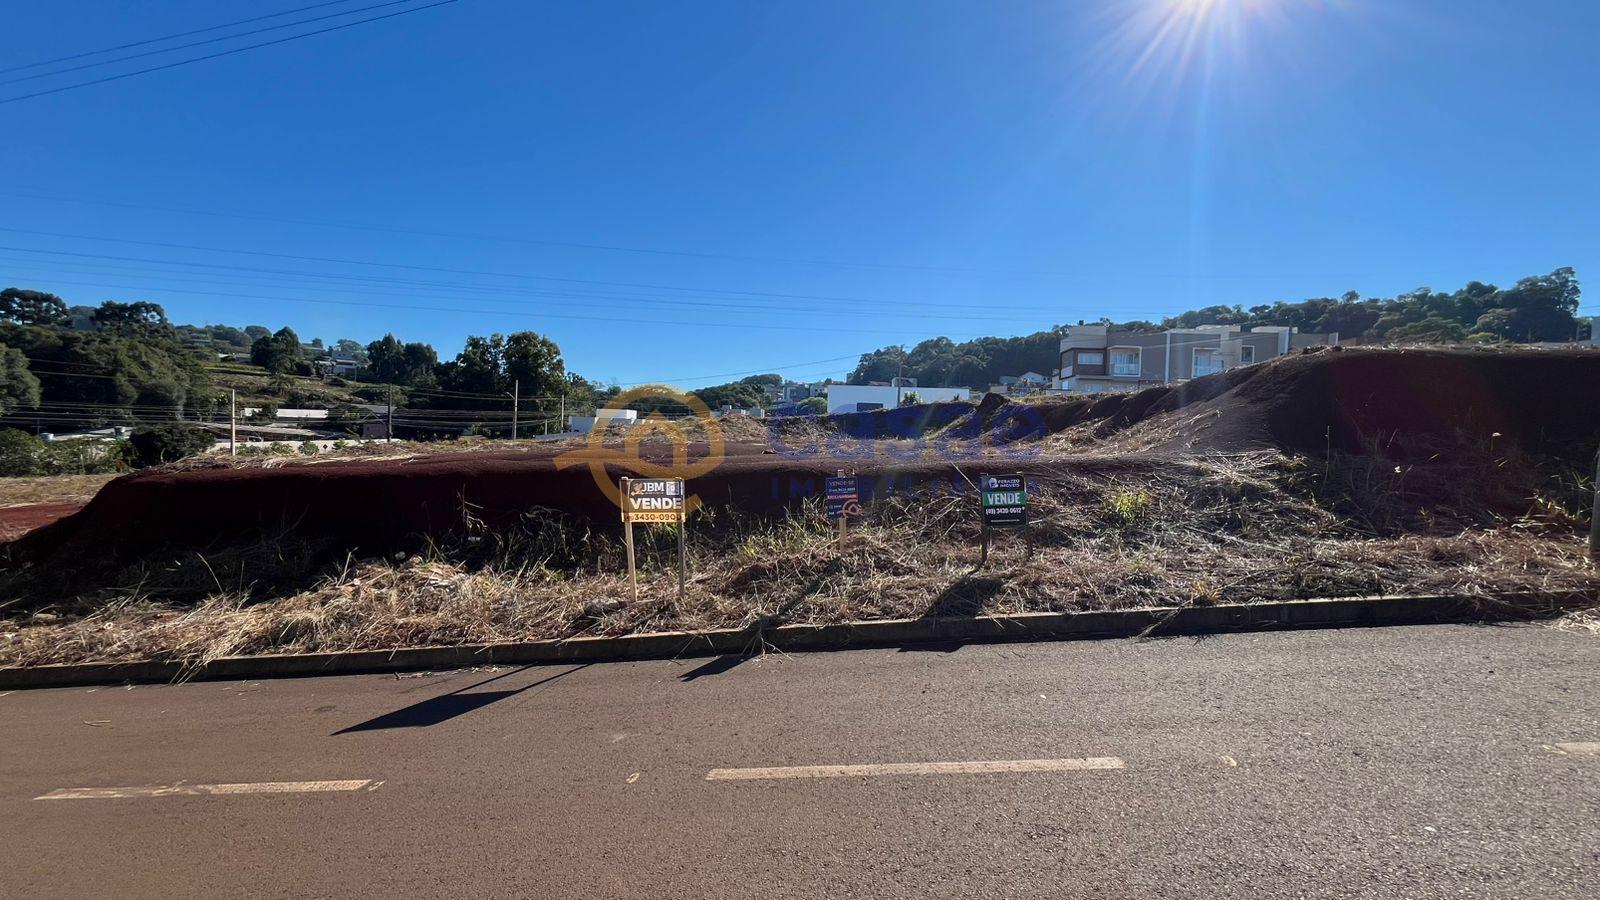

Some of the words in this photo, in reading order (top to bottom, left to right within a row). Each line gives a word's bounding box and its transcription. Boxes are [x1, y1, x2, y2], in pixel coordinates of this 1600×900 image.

[642, 482, 665, 492] JBM
[629, 497, 682, 510] VENDE
[987, 492, 1021, 505] VENDE
